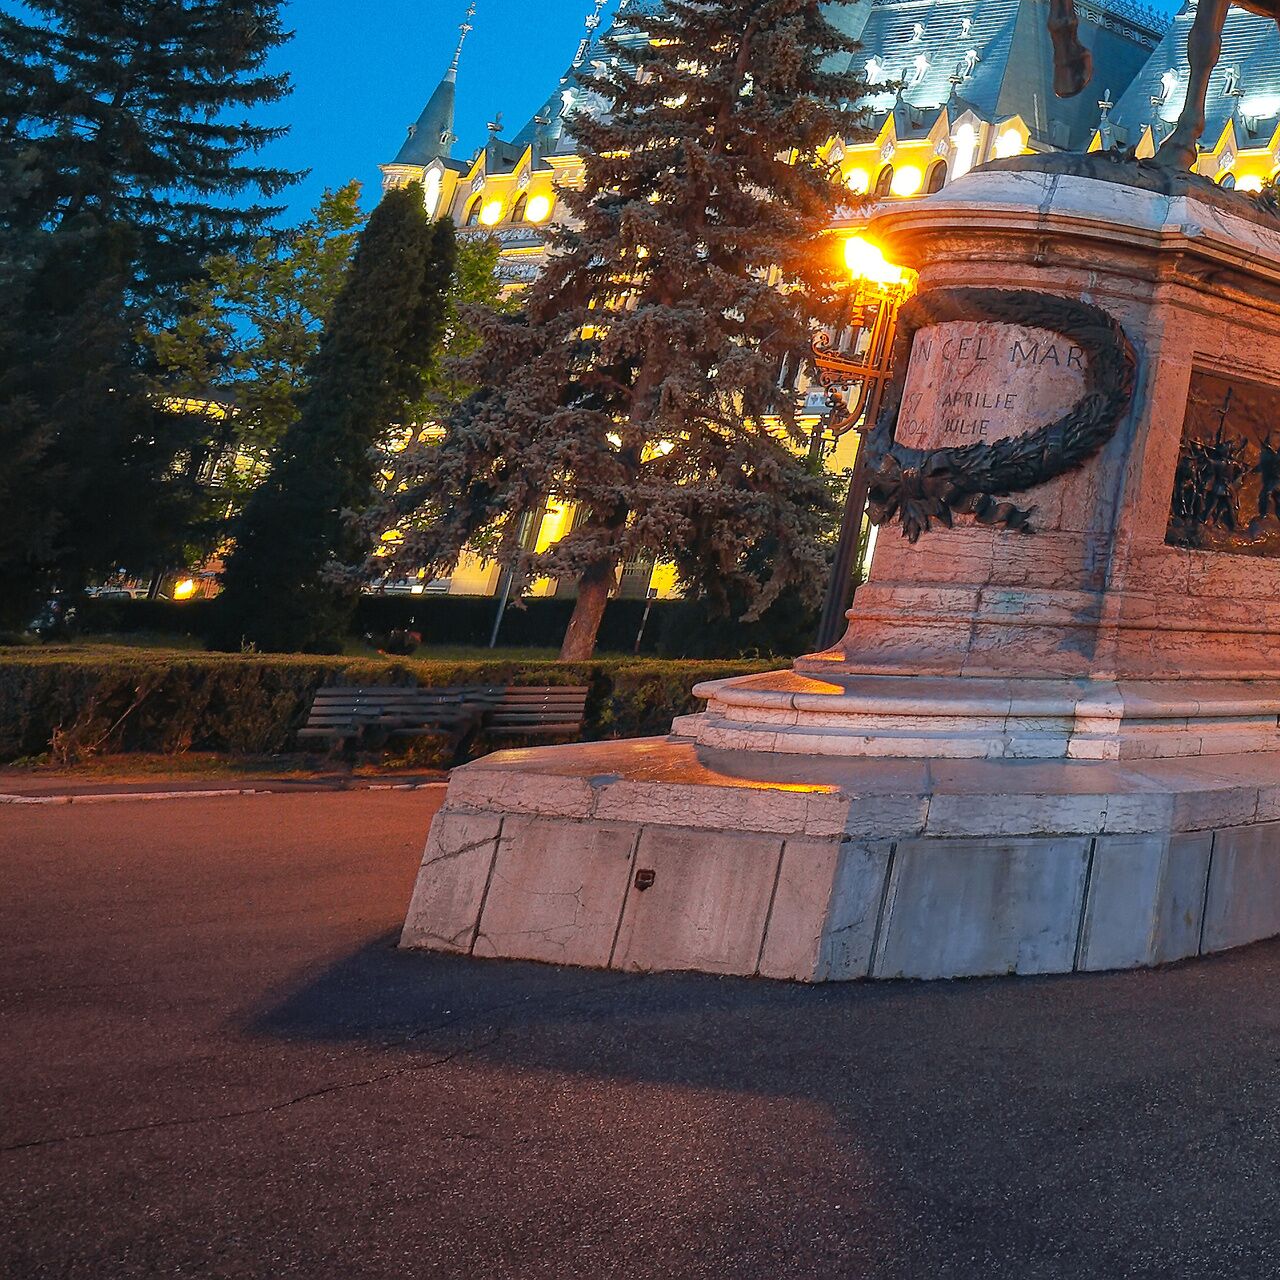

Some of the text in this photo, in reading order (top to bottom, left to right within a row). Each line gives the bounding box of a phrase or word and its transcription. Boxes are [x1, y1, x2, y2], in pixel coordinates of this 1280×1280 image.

[942, 337, 988, 361] CEL
[1009, 340, 1084, 369] MAR
[941, 391, 1018, 410] APRILIE
